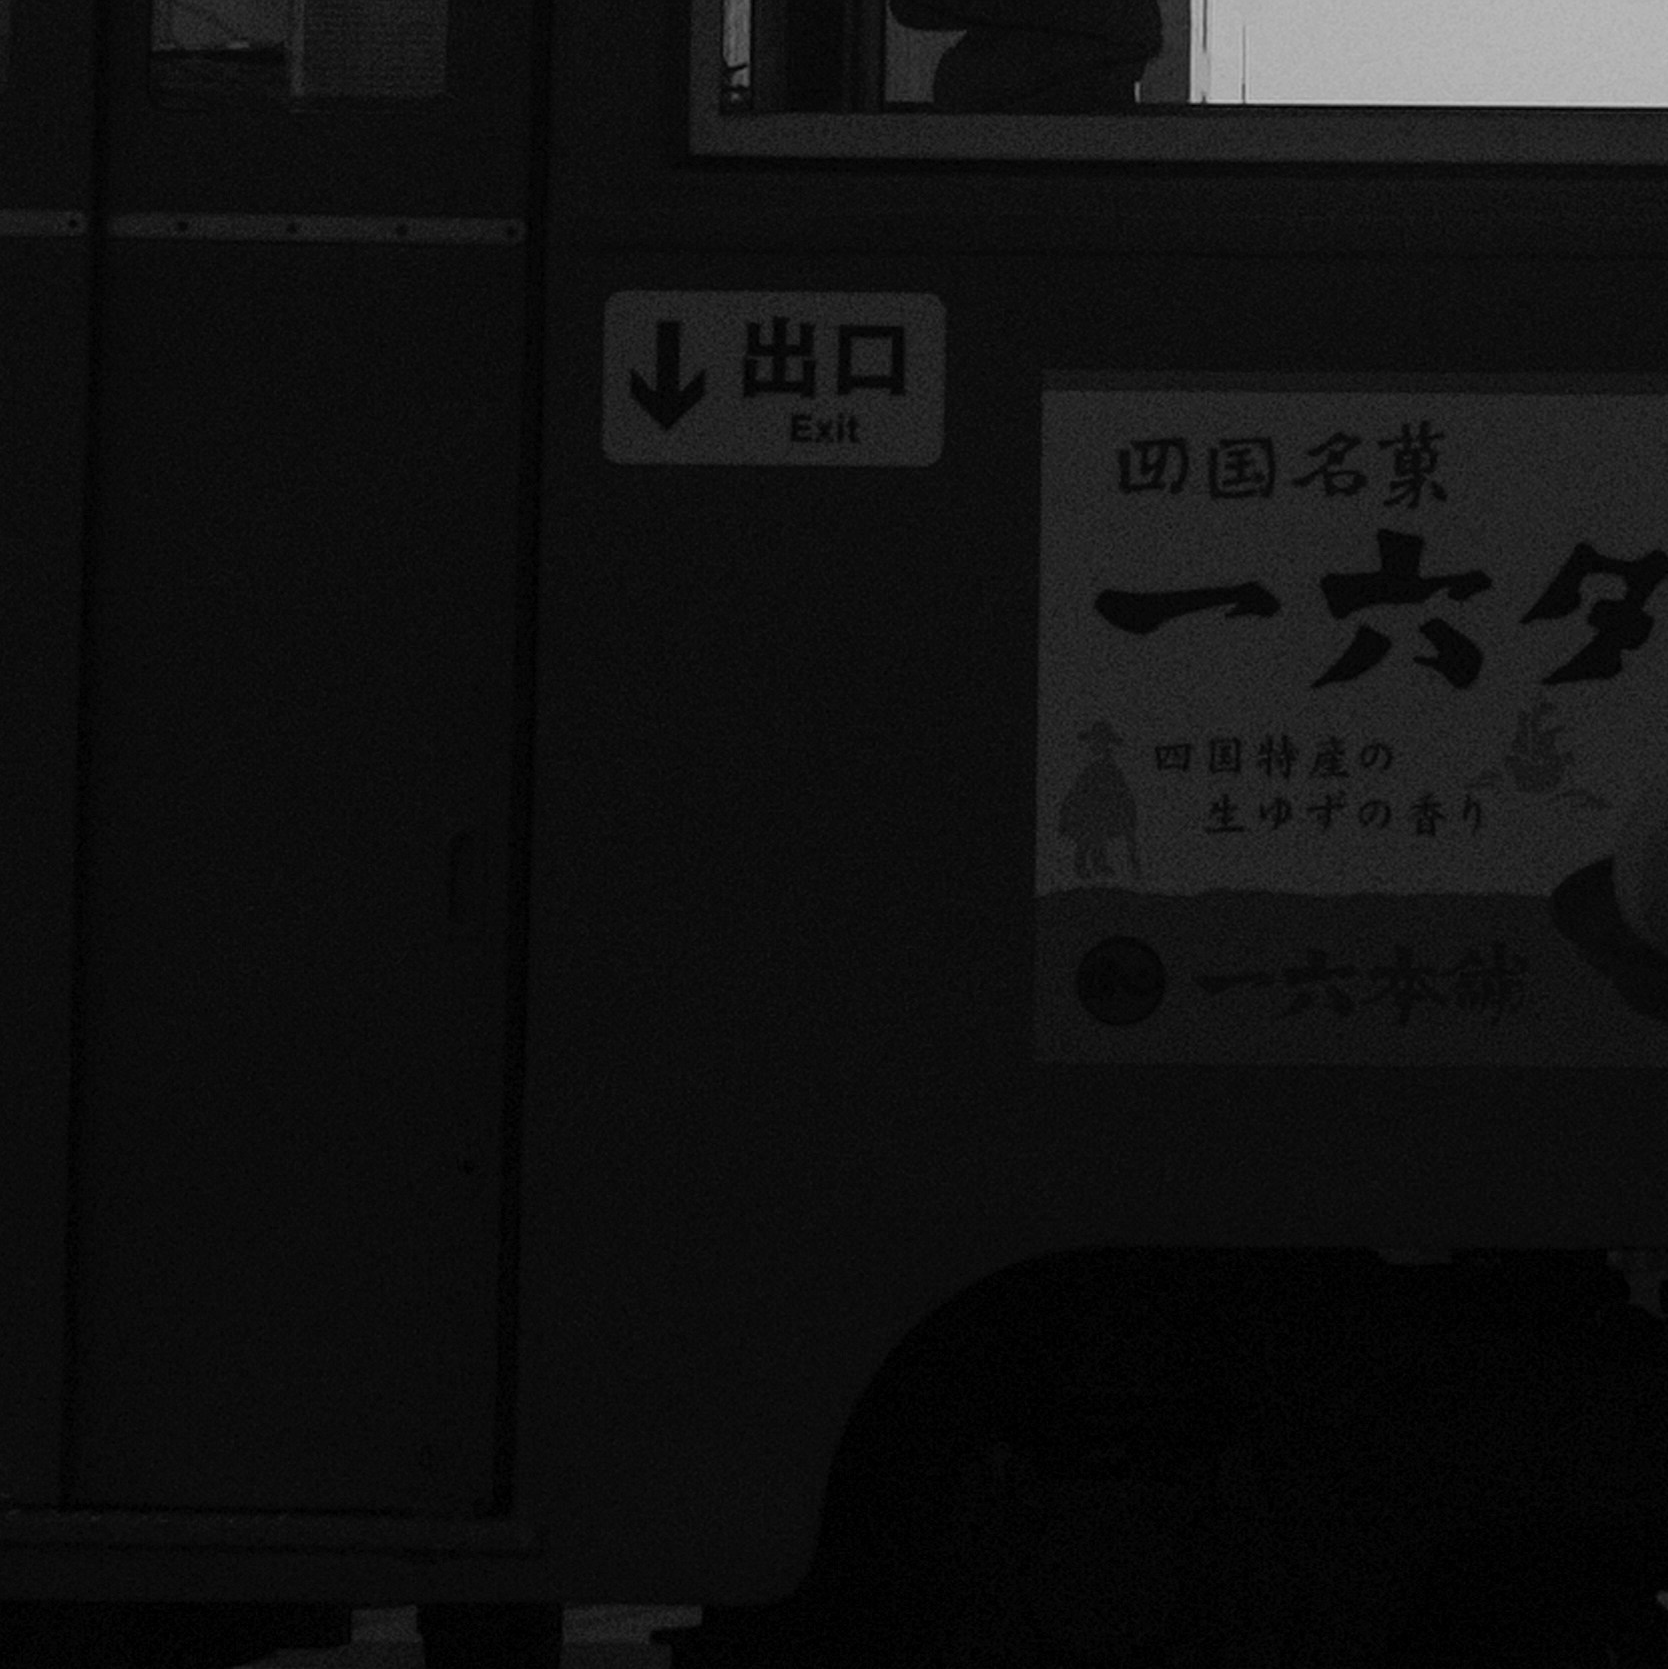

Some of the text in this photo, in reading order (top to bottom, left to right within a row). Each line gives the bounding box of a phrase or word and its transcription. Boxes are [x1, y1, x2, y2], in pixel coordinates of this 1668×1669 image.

[744, 316, 905, 398] 出口
[791, 413, 860, 444] Exit
[1115, 420, 1450, 509] 四国名菓
[1153, 734, 1395, 780] 四国特産の
[1203, 789, 1485, 837] 生ゆずの香り
